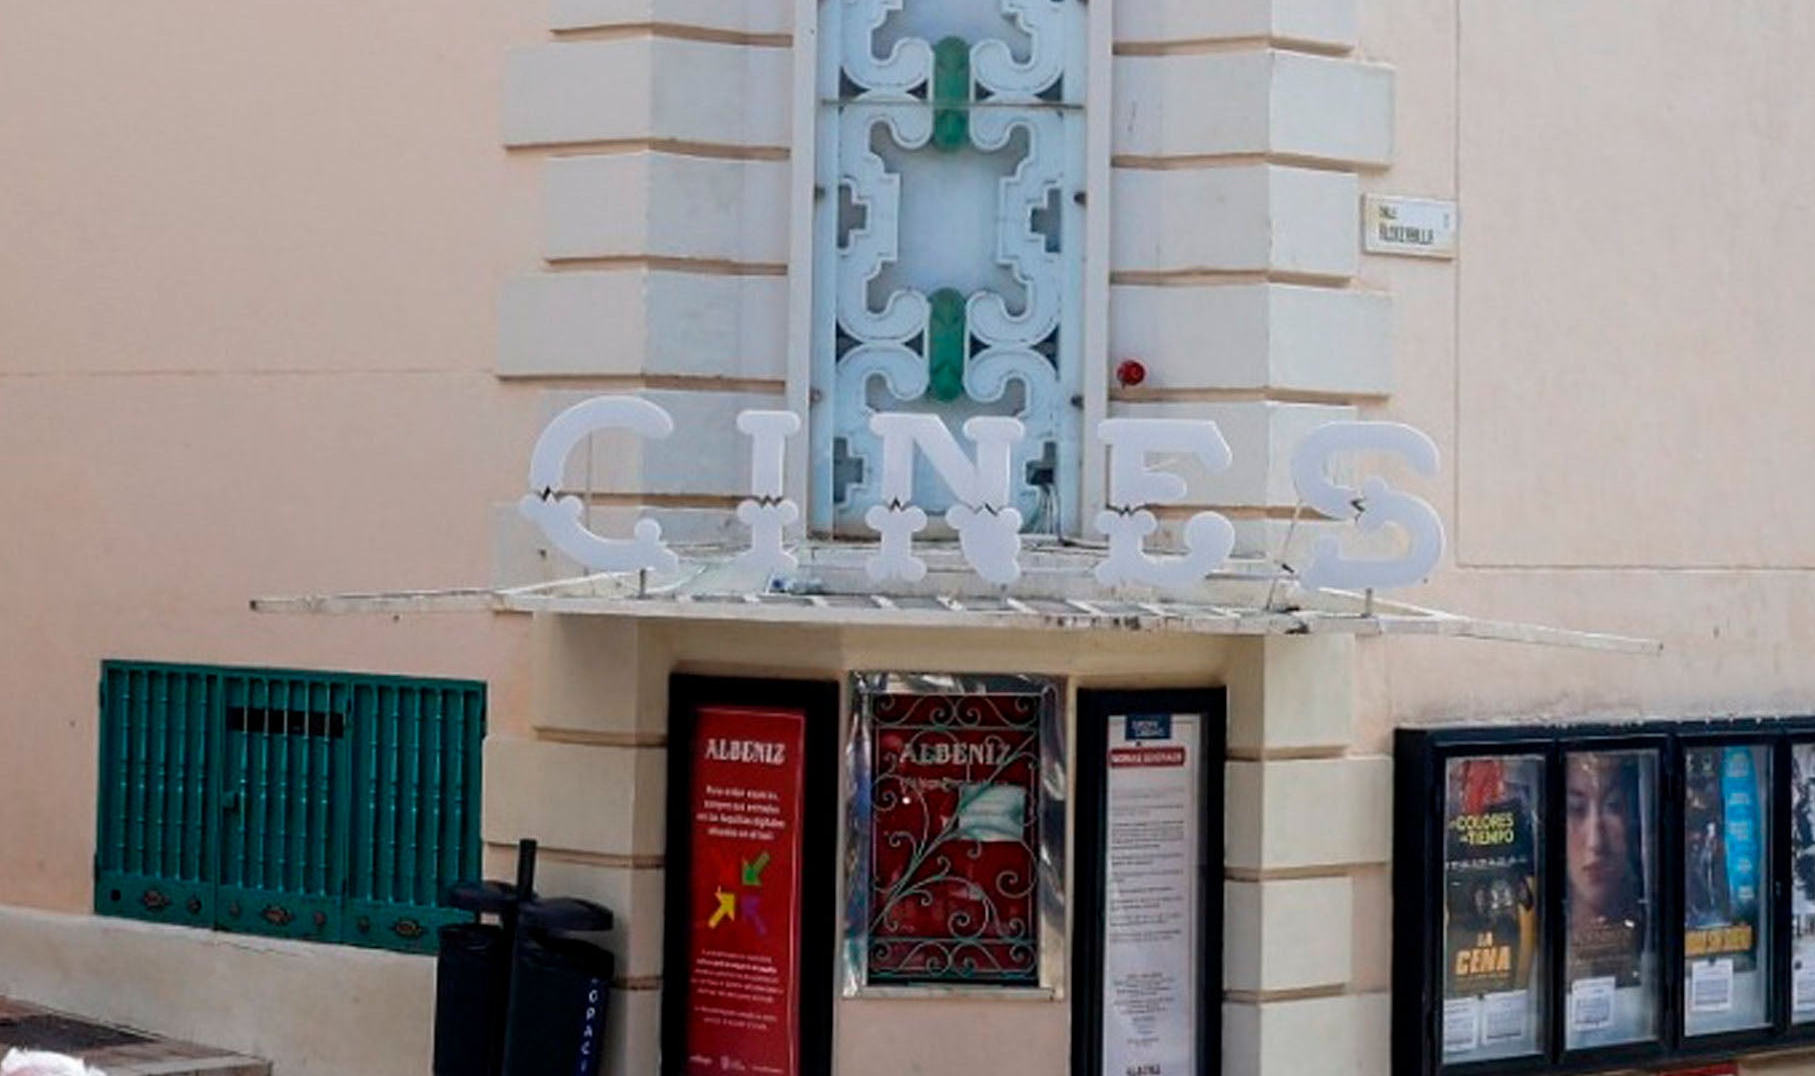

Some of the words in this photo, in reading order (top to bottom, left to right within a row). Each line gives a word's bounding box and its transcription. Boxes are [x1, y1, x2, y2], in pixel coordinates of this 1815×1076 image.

[519, 395, 1446, 591] CINES
[704, 737, 786, 766] ALBENIZ
[899, 742, 1011, 766] ALBENIZ
[1456, 812, 1514, 831] COLORES
[1468, 828, 1515, 845] TIEMPO
[1456, 945, 1511, 975] CENA
